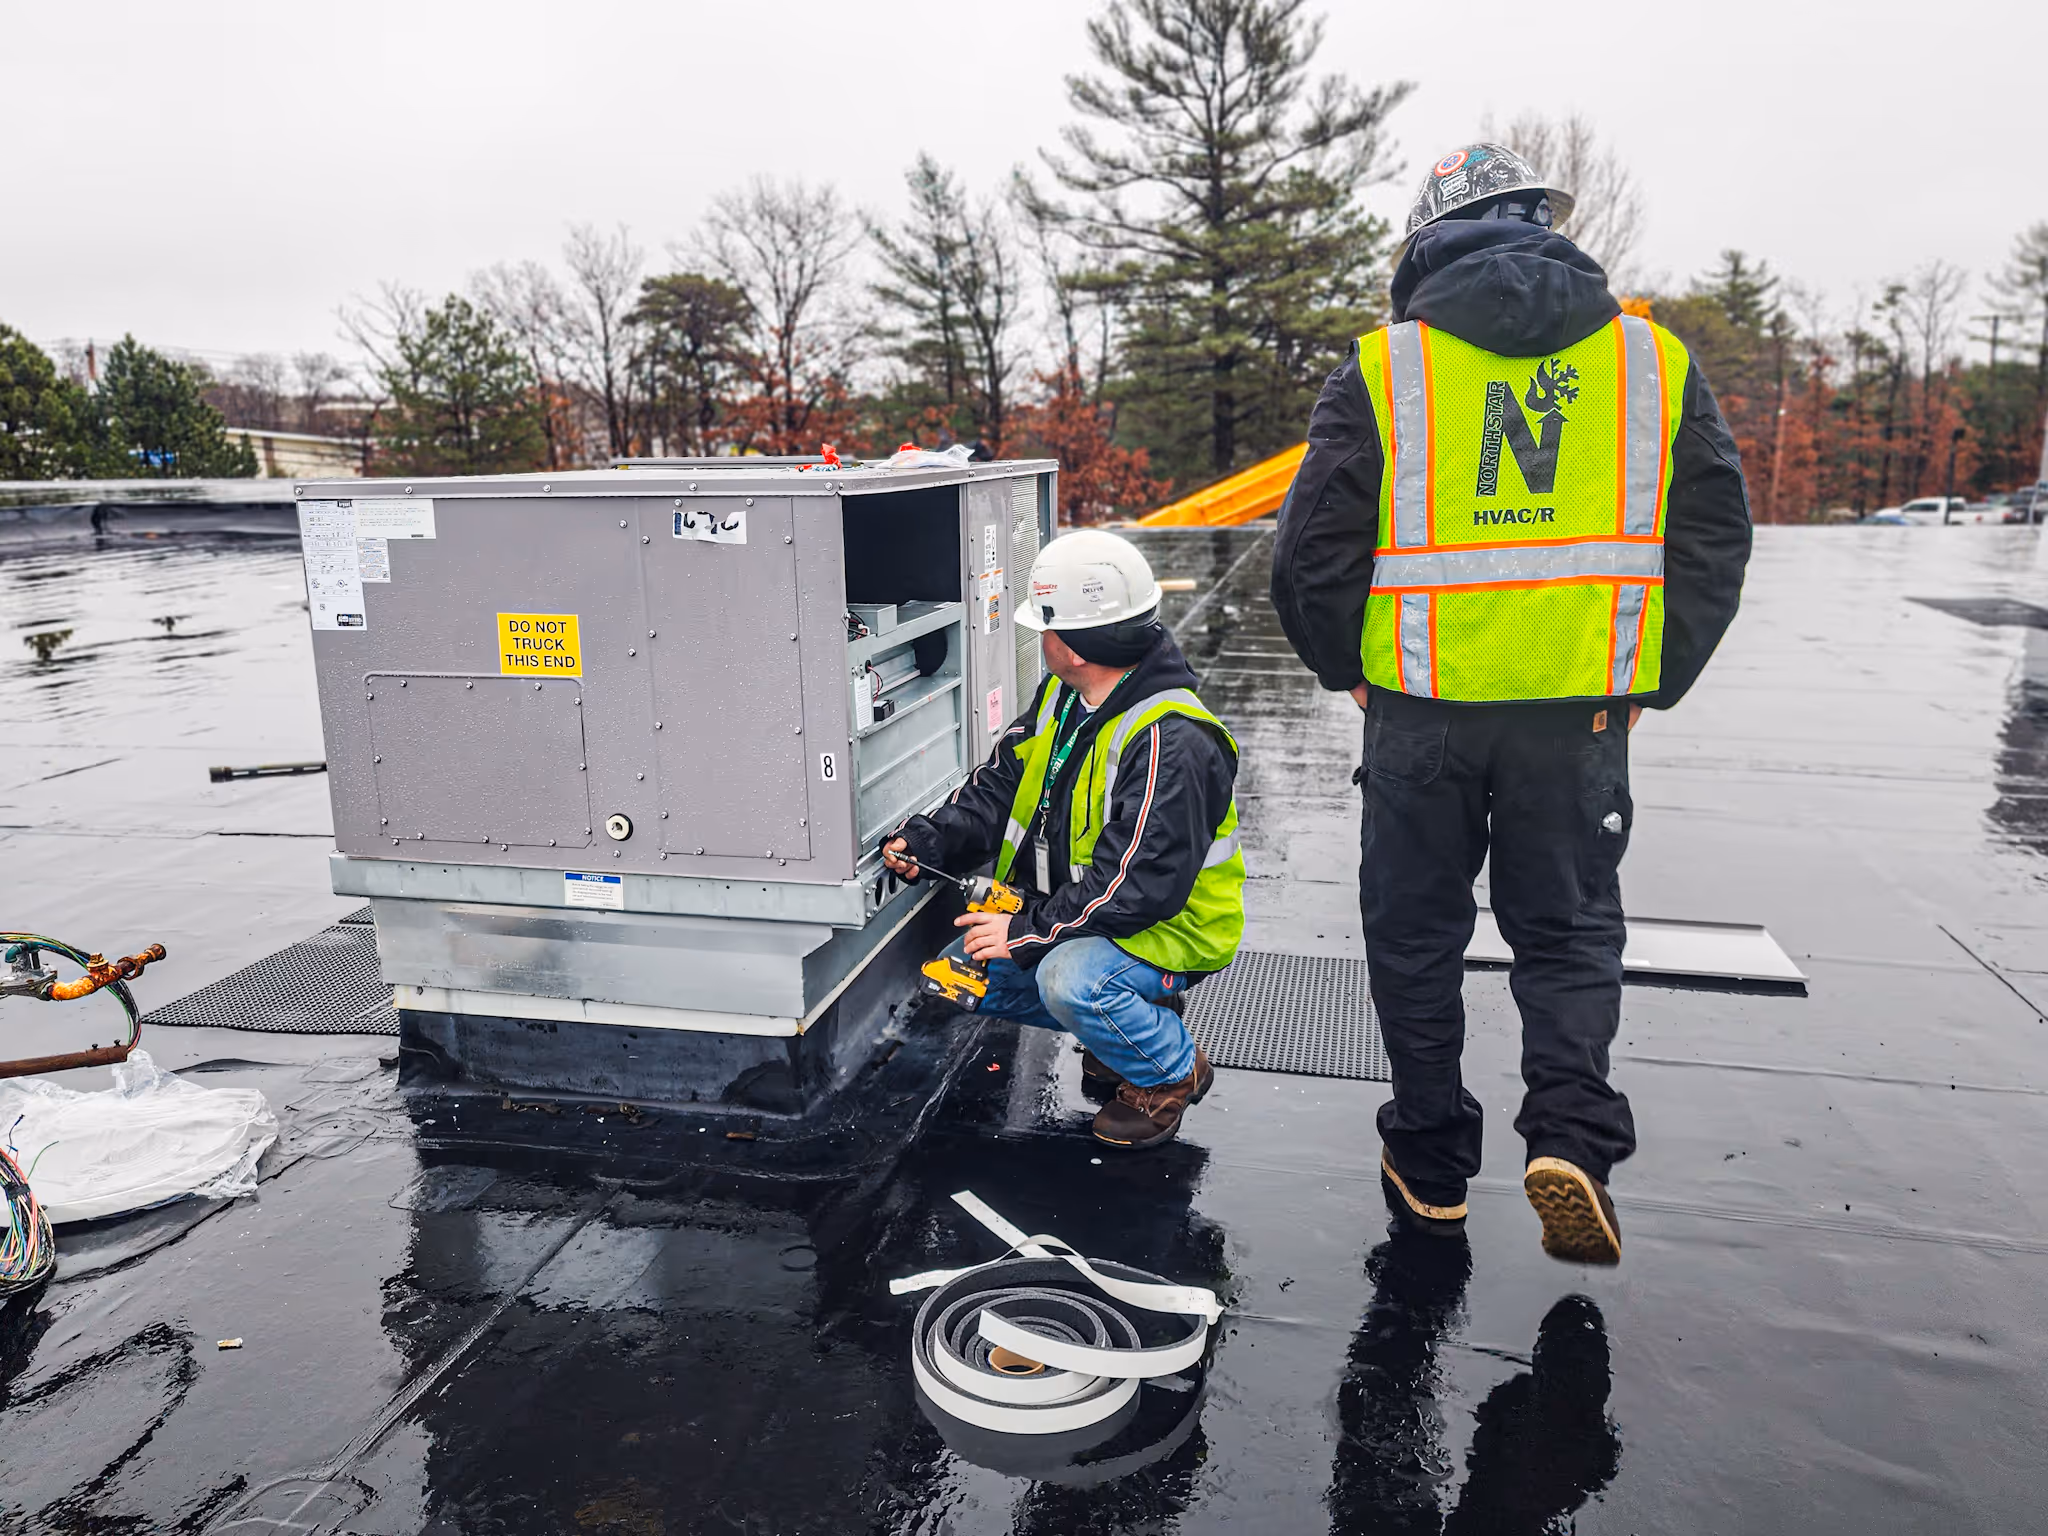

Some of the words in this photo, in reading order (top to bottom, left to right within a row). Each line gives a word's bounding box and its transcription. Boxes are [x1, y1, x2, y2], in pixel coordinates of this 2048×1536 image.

[1477, 380, 1506, 497] NORTHSTAR
[1473, 507, 1555, 526] HVAC/R
[509, 620, 531, 633] DO
[536, 621, 567, 634] NOT
[512, 638, 565, 651] TRUCK
[505, 654, 539, 667] THIS
[543, 655, 575, 668] END
[823, 755, 834, 778] 8
